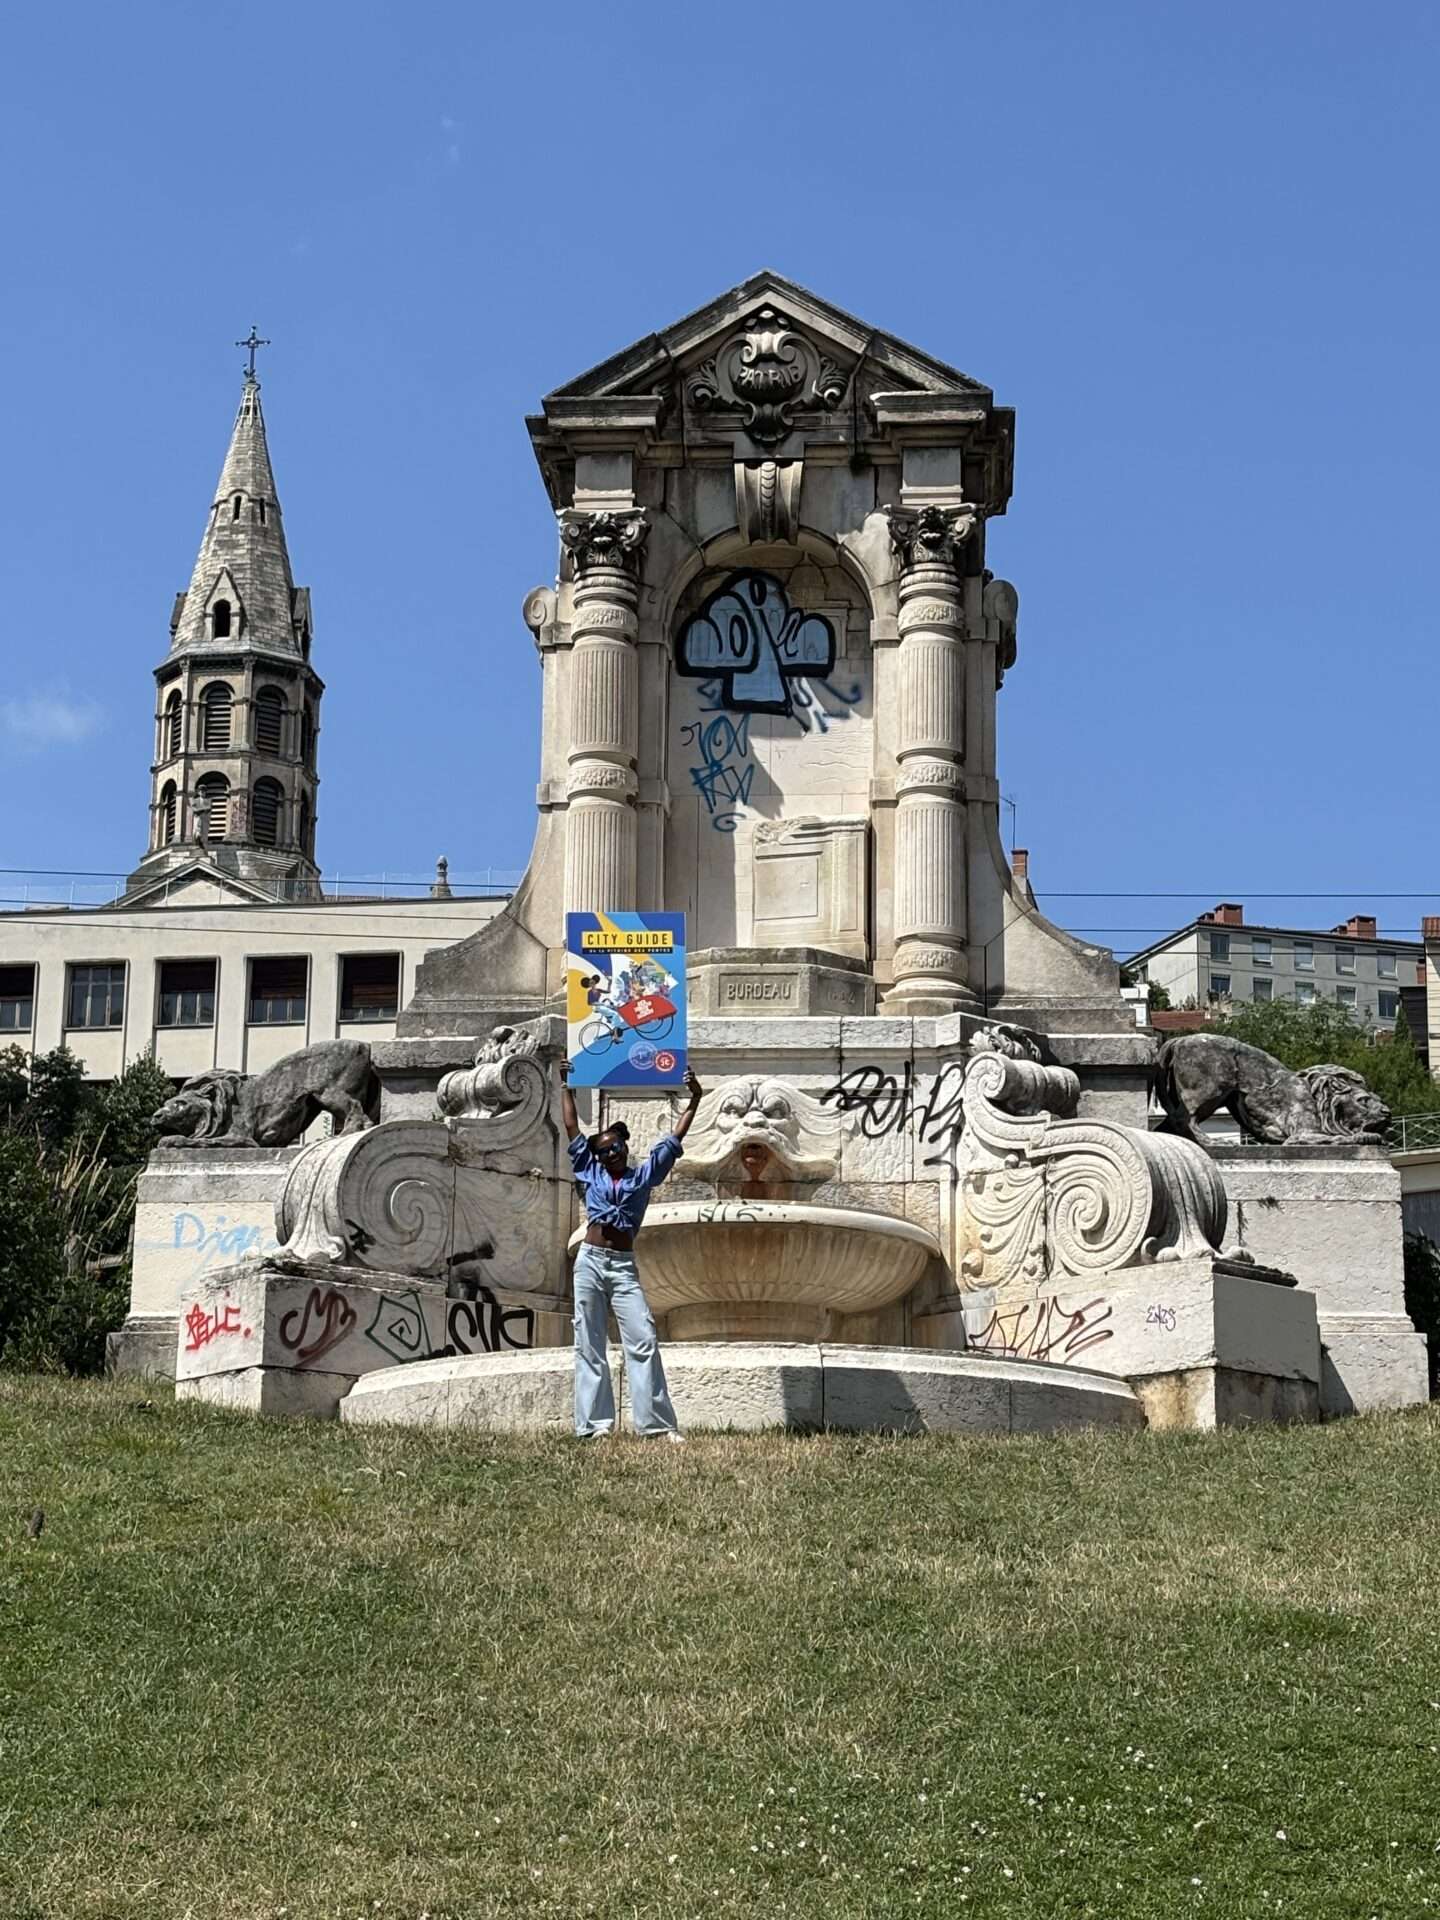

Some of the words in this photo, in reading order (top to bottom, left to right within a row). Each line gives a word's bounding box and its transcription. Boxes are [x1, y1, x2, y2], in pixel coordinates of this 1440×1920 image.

[587, 933, 618, 946] CITY
[626, 933, 668, 946] GUIDE
[727, 982, 792, 1000] BURDEAU
